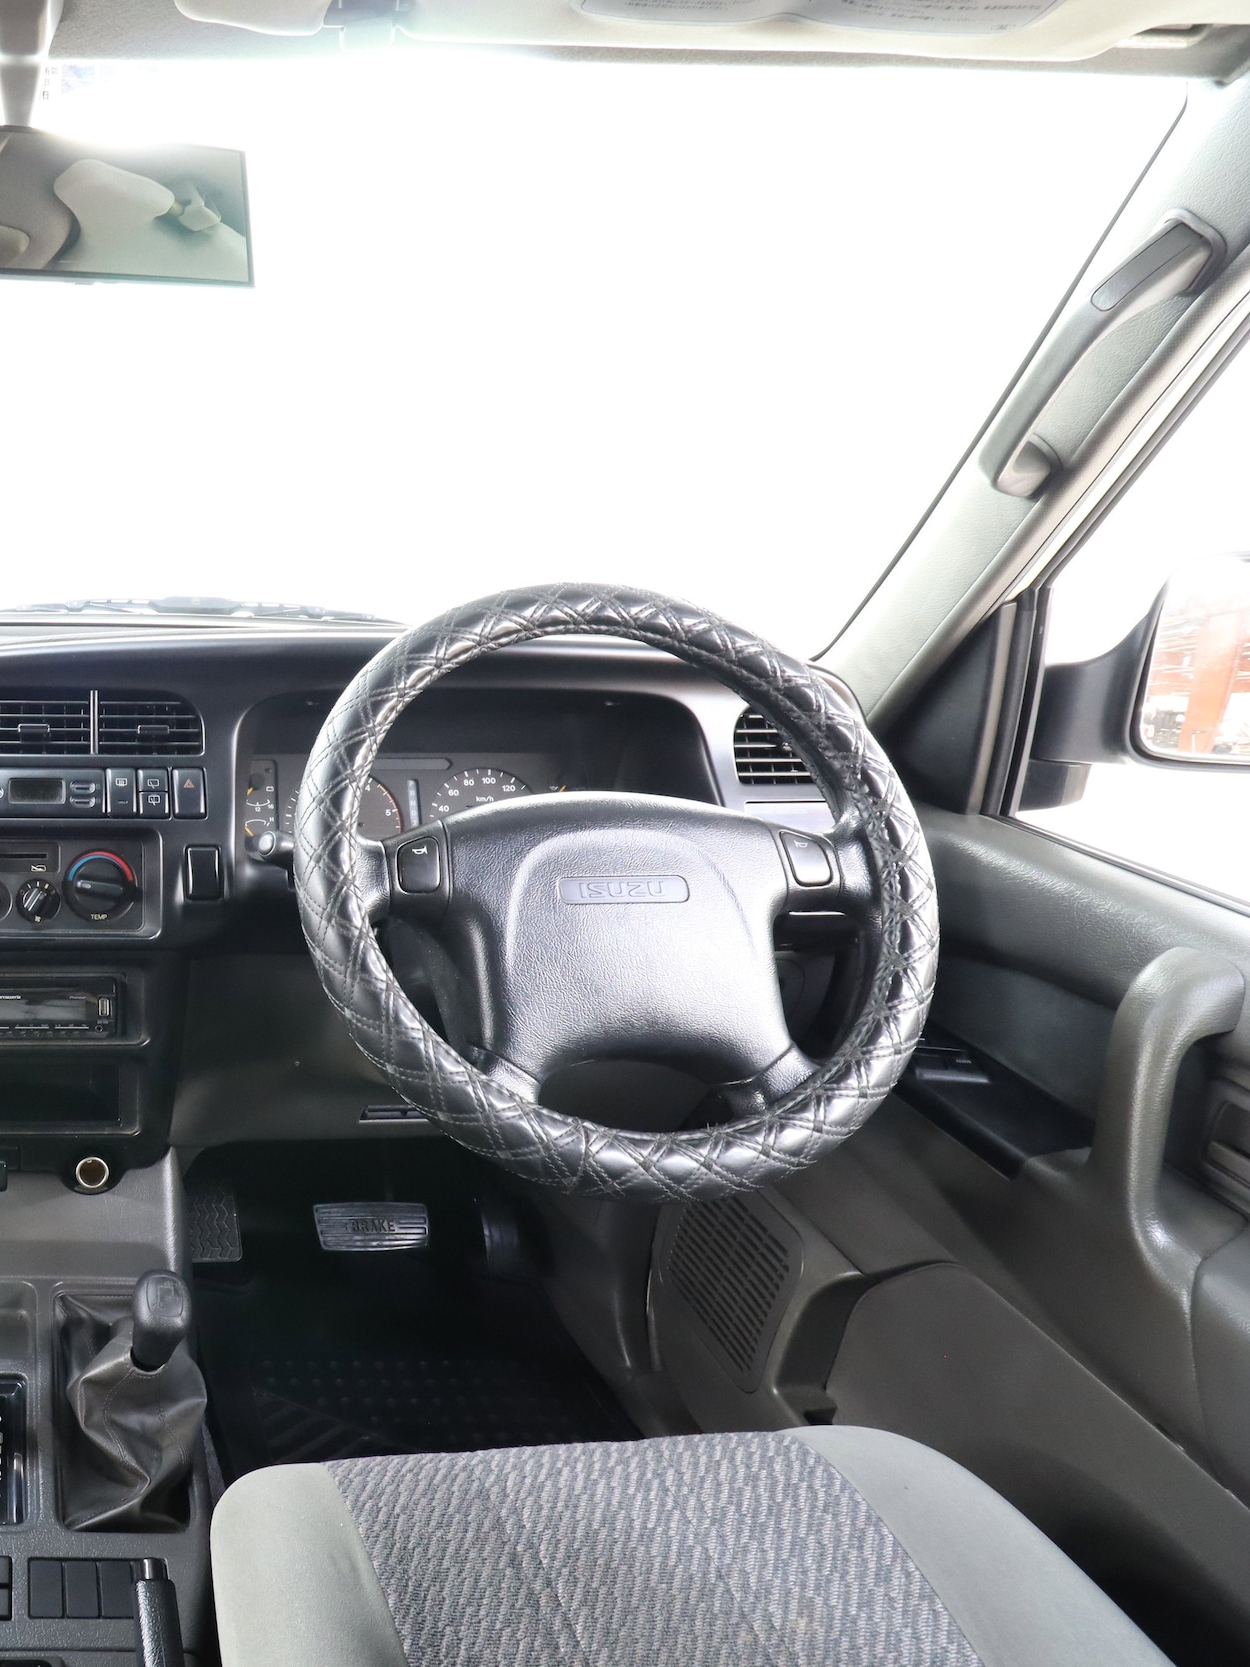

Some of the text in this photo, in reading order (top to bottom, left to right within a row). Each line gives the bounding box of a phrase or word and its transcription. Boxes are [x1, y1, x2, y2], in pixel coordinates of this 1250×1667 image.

[448, 789, 459, 797] 60
[438, 804, 450, 812] 40
[579, 881, 667, 899] ISUZU
[90, 913, 108, 921] TEMP
[350, 1219, 396, 1232] BRAKE
